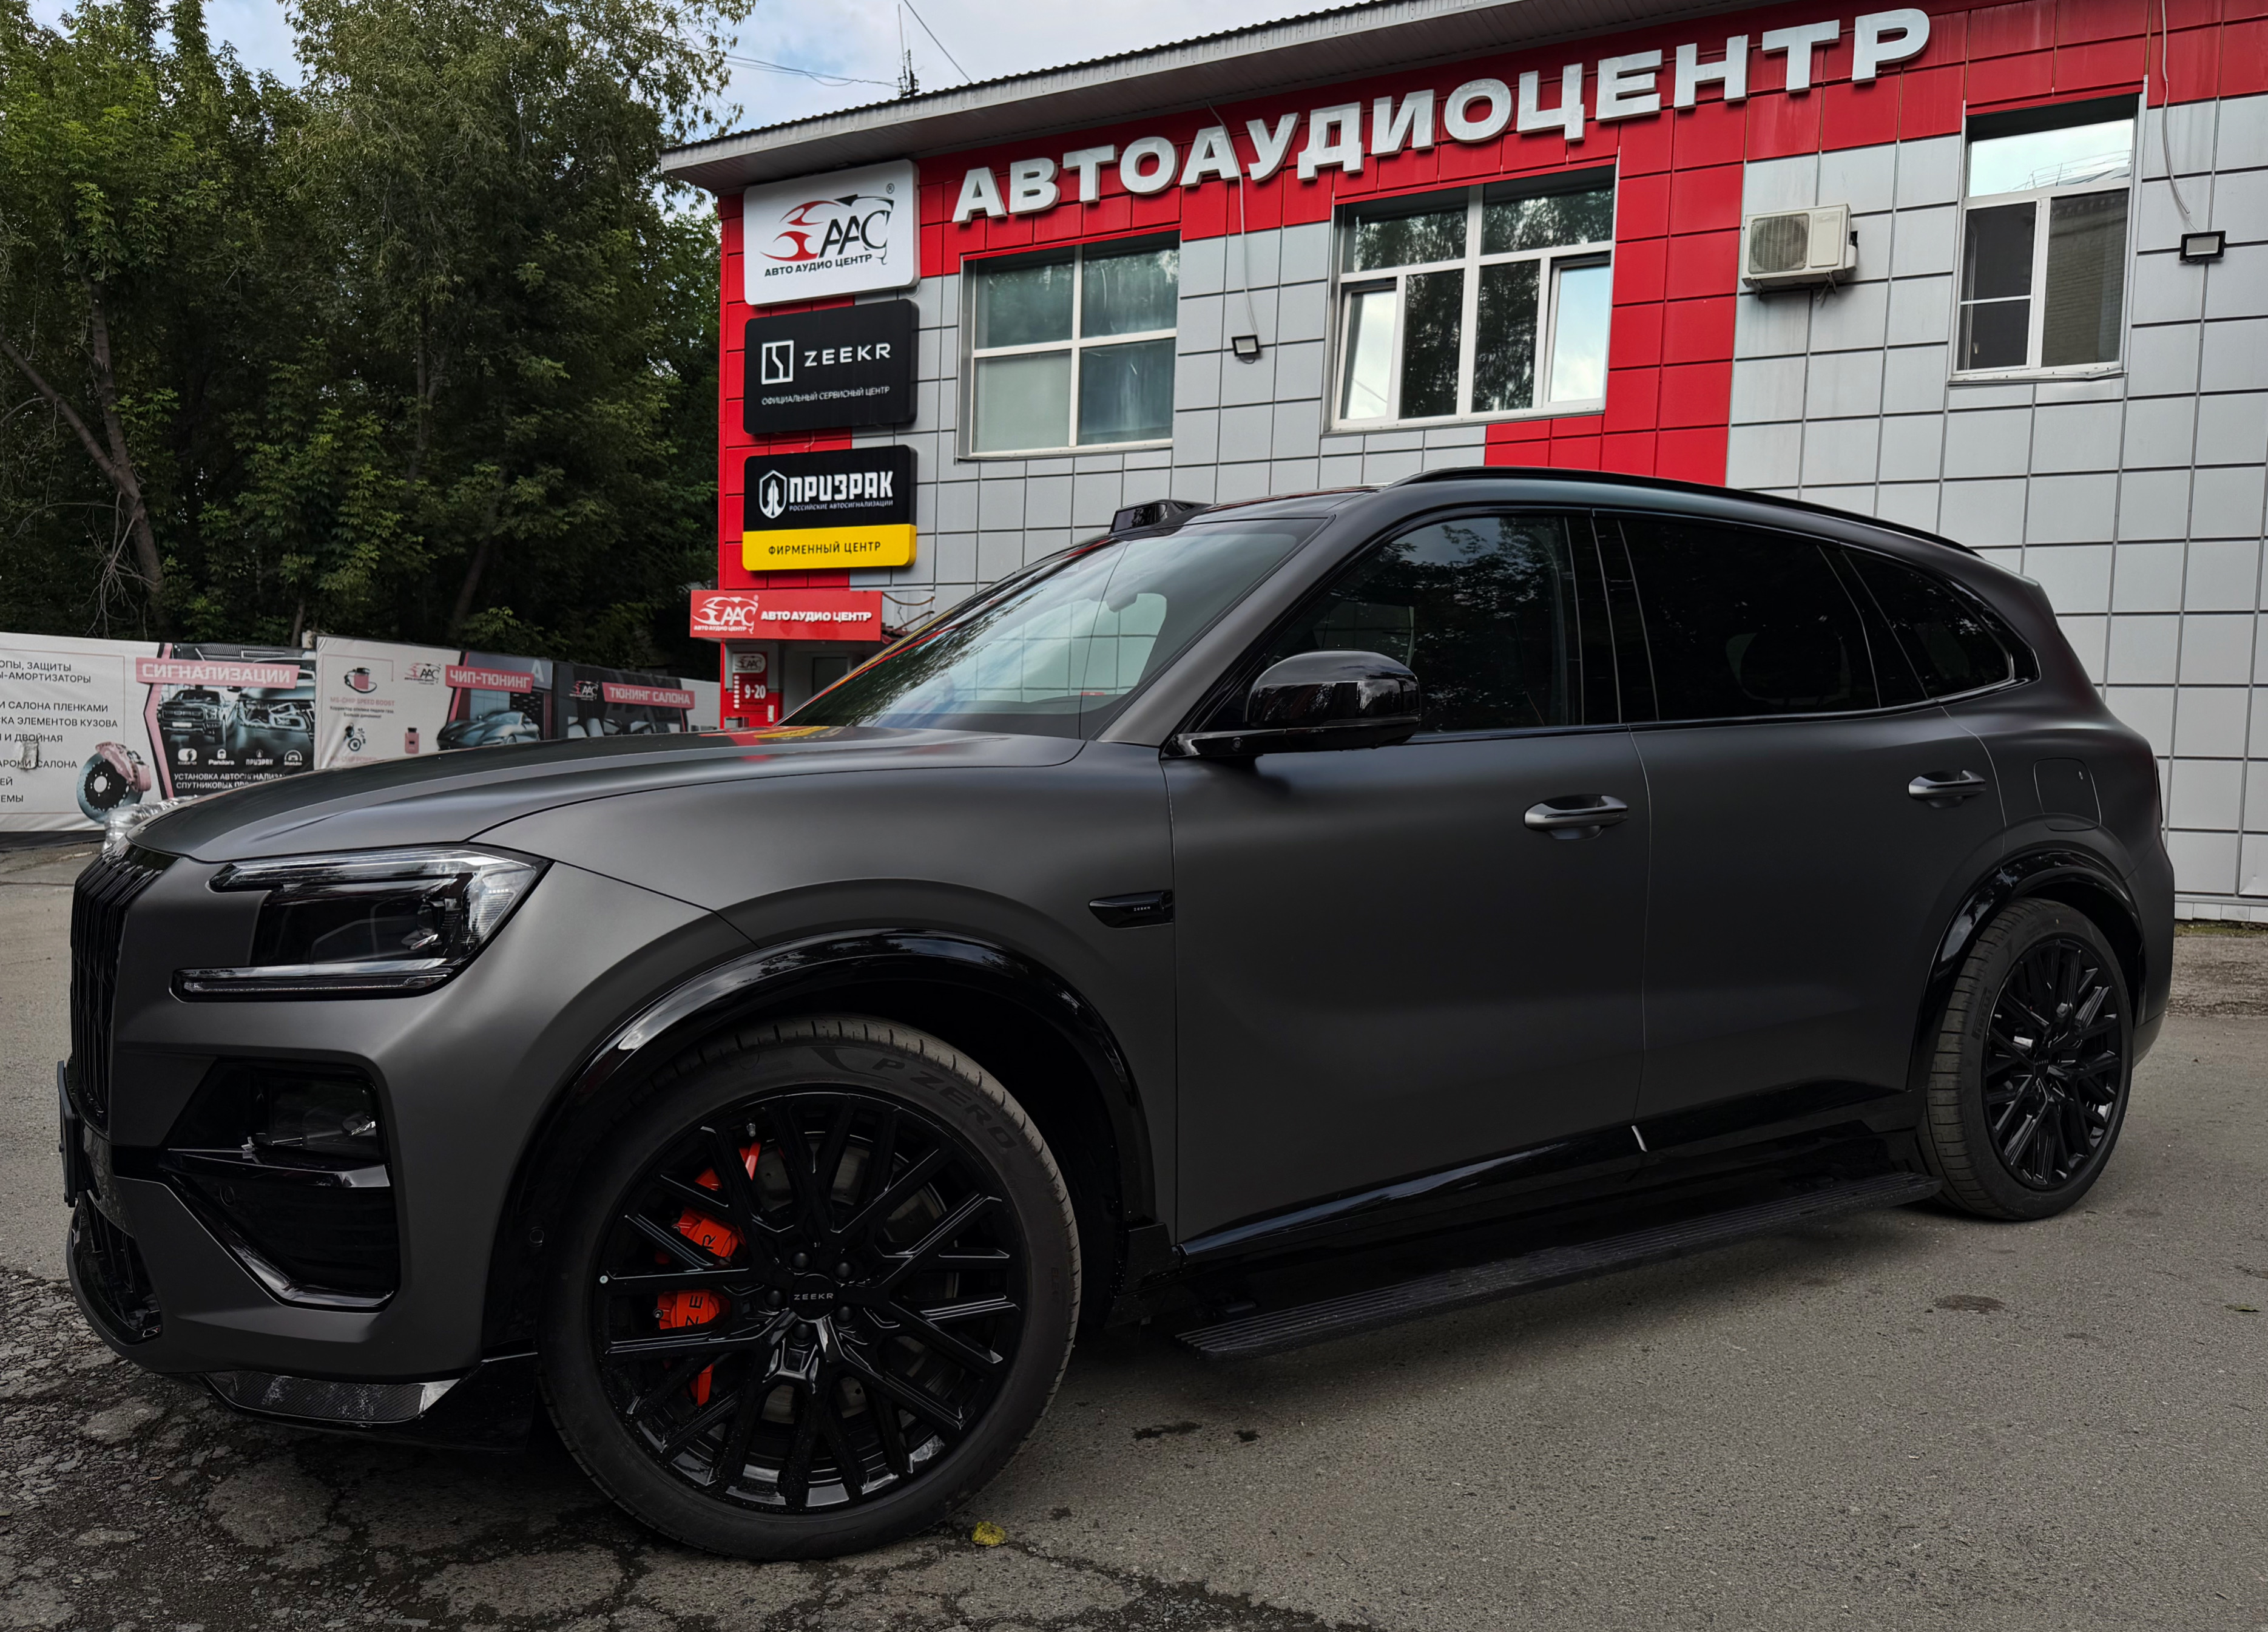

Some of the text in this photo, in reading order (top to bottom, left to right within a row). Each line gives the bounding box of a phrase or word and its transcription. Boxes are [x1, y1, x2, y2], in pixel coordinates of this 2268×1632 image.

[951, 8, 1931, 224] АВТОАУДИОЦЕНТР
[764, 254, 872, 277] АВТО АУДИО ЦЕНТР
[804, 343, 891, 367] ZEEKR
[761, 385, 890, 405] ОФИЦИАЛЬНЫЙ СЕРВИСНЫЙ ЦЕНТР
[789, 470, 893, 503] ПРИЗРАК
[789, 499, 893, 512] РОССИЙСКИЕ АВТОСИГНАЛИЗАЦИИ
[768, 541, 881, 555] ФИРМЕННЫЙ ЦЕНТР
[760, 611, 872, 623] АВТО АУДИО ЦЕНТР
[27, 662, 72, 672] ЗАЩИТЫ
[142, 663, 290, 684] СИГНАЛИЗАЦИИ
[450, 669, 530, 689] ЧИП-ТЮНИНГ
[609, 686, 690, 705] ТЮНИНГ САЛОНА
[744, 684, 766, 699] 9-20
[8, 701, 50, 710] САЛОНА
[53, 703, 108, 713] ПЛЕНКАМИ
[18, 717, 77, 726] ЭЛЕМЕНТОВ
[80, 719, 118, 728] КУЗОВА
[15, 733, 62, 743] ДВОЙНАЯ
[35, 760, 78, 768] САЛОНА
[0, 776, 13, 786] ЕЙ
[174, 773, 218, 781] УСТАНОВКА
[0, 794, 23, 803] ЕМЫ
[871, 1057, 1021, 1150] P ZERO
